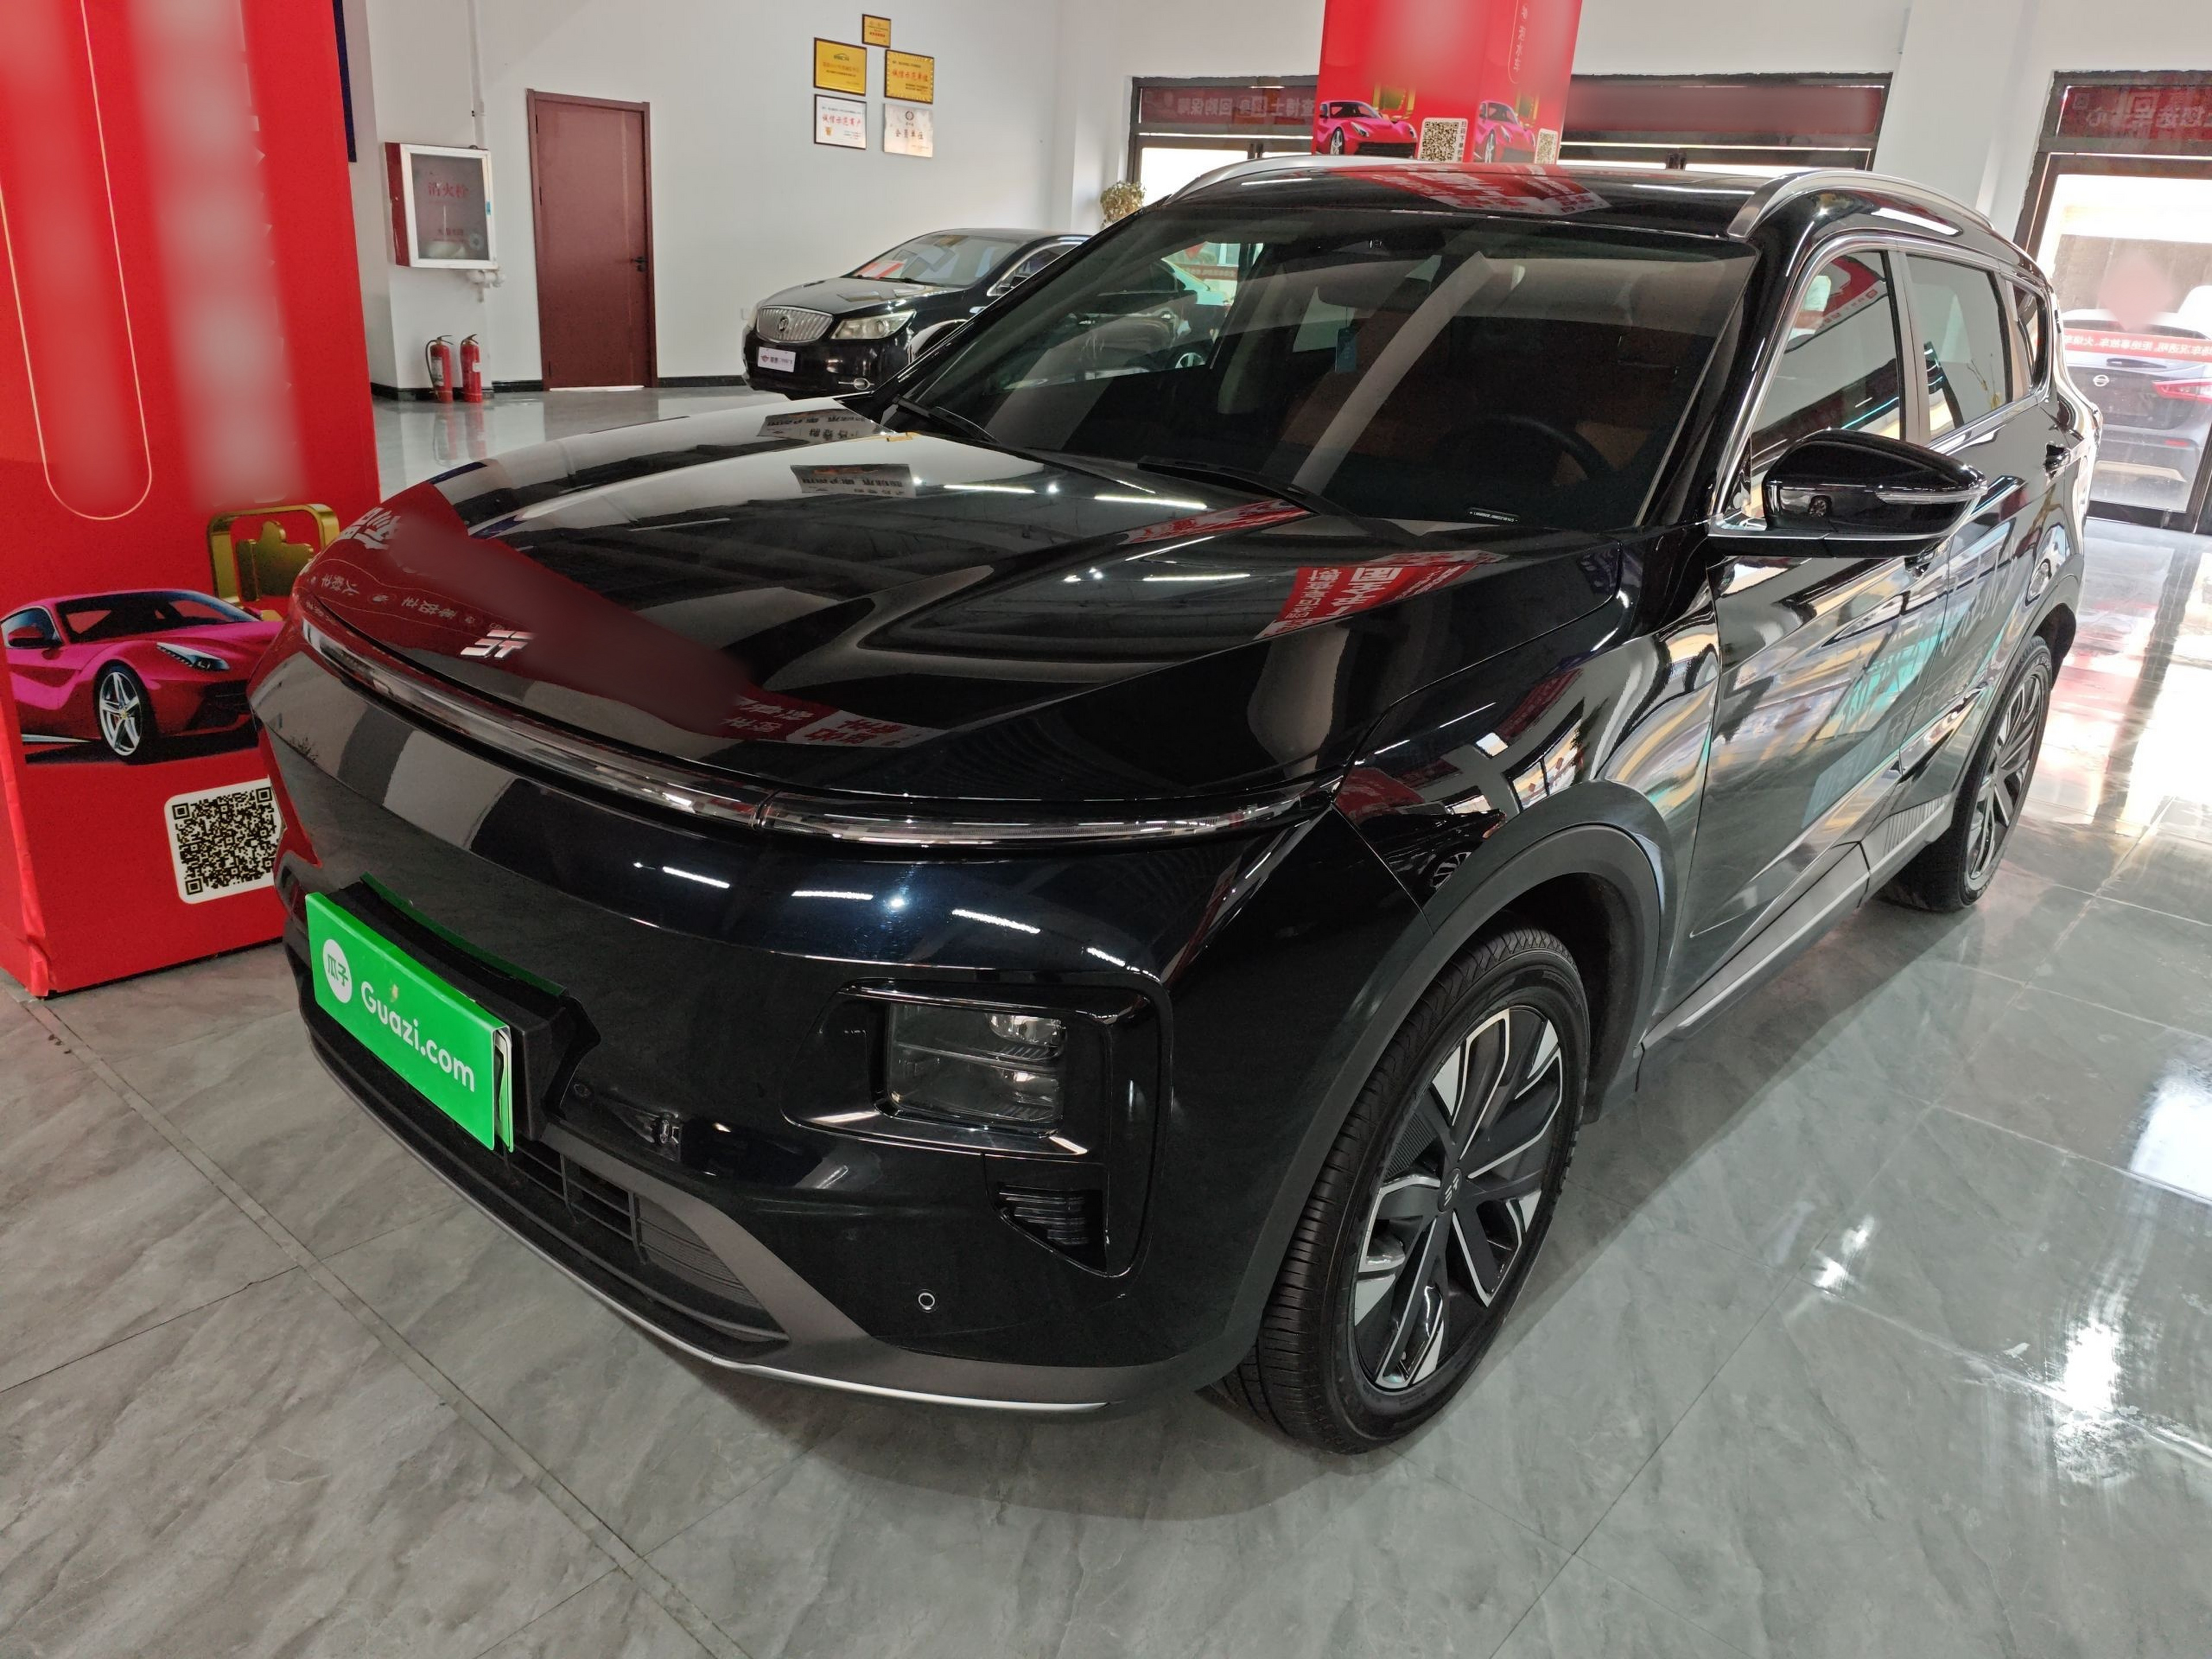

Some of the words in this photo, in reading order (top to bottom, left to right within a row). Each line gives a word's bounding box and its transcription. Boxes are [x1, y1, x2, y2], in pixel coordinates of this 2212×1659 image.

[428, 181, 469, 198] 消火栓
[327, 953, 349, 988] 瓜子
[361, 981, 475, 1092] Guazi.com
